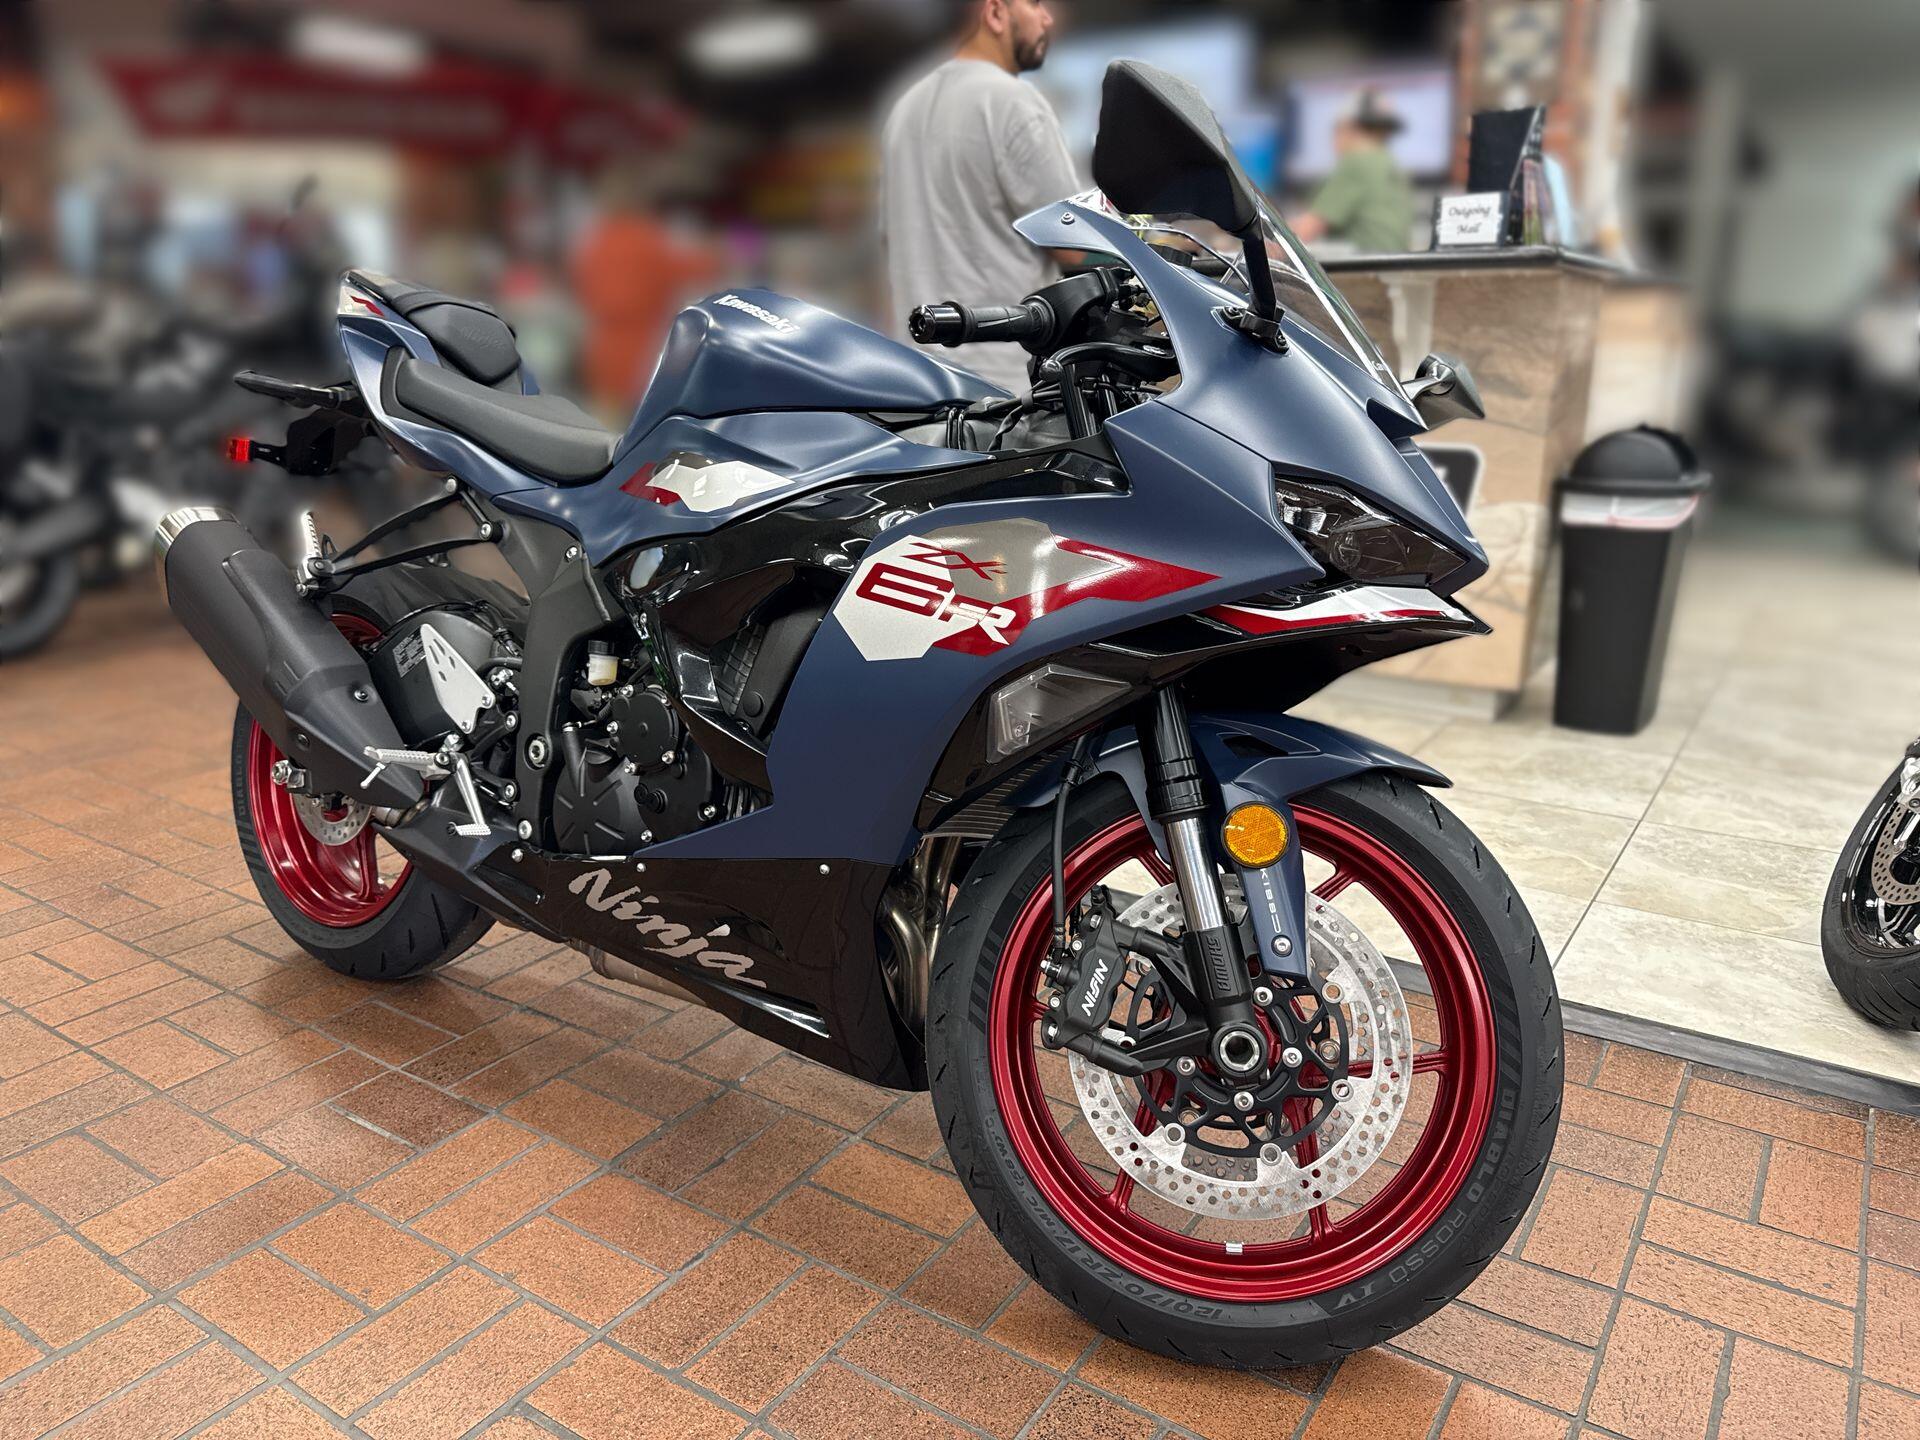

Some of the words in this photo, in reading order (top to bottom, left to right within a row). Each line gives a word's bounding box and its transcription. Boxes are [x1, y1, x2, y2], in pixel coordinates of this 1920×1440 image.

[712, 294, 800, 333] Kawasaki
[568, 868, 767, 989] Ninja
[1081, 958, 1109, 1017] NISSIN
[1207, 935, 1232, 992] SHOWA
[1465, 1088, 1516, 1204] DIABLO
[1388, 1208, 1467, 1284] ROSSO
